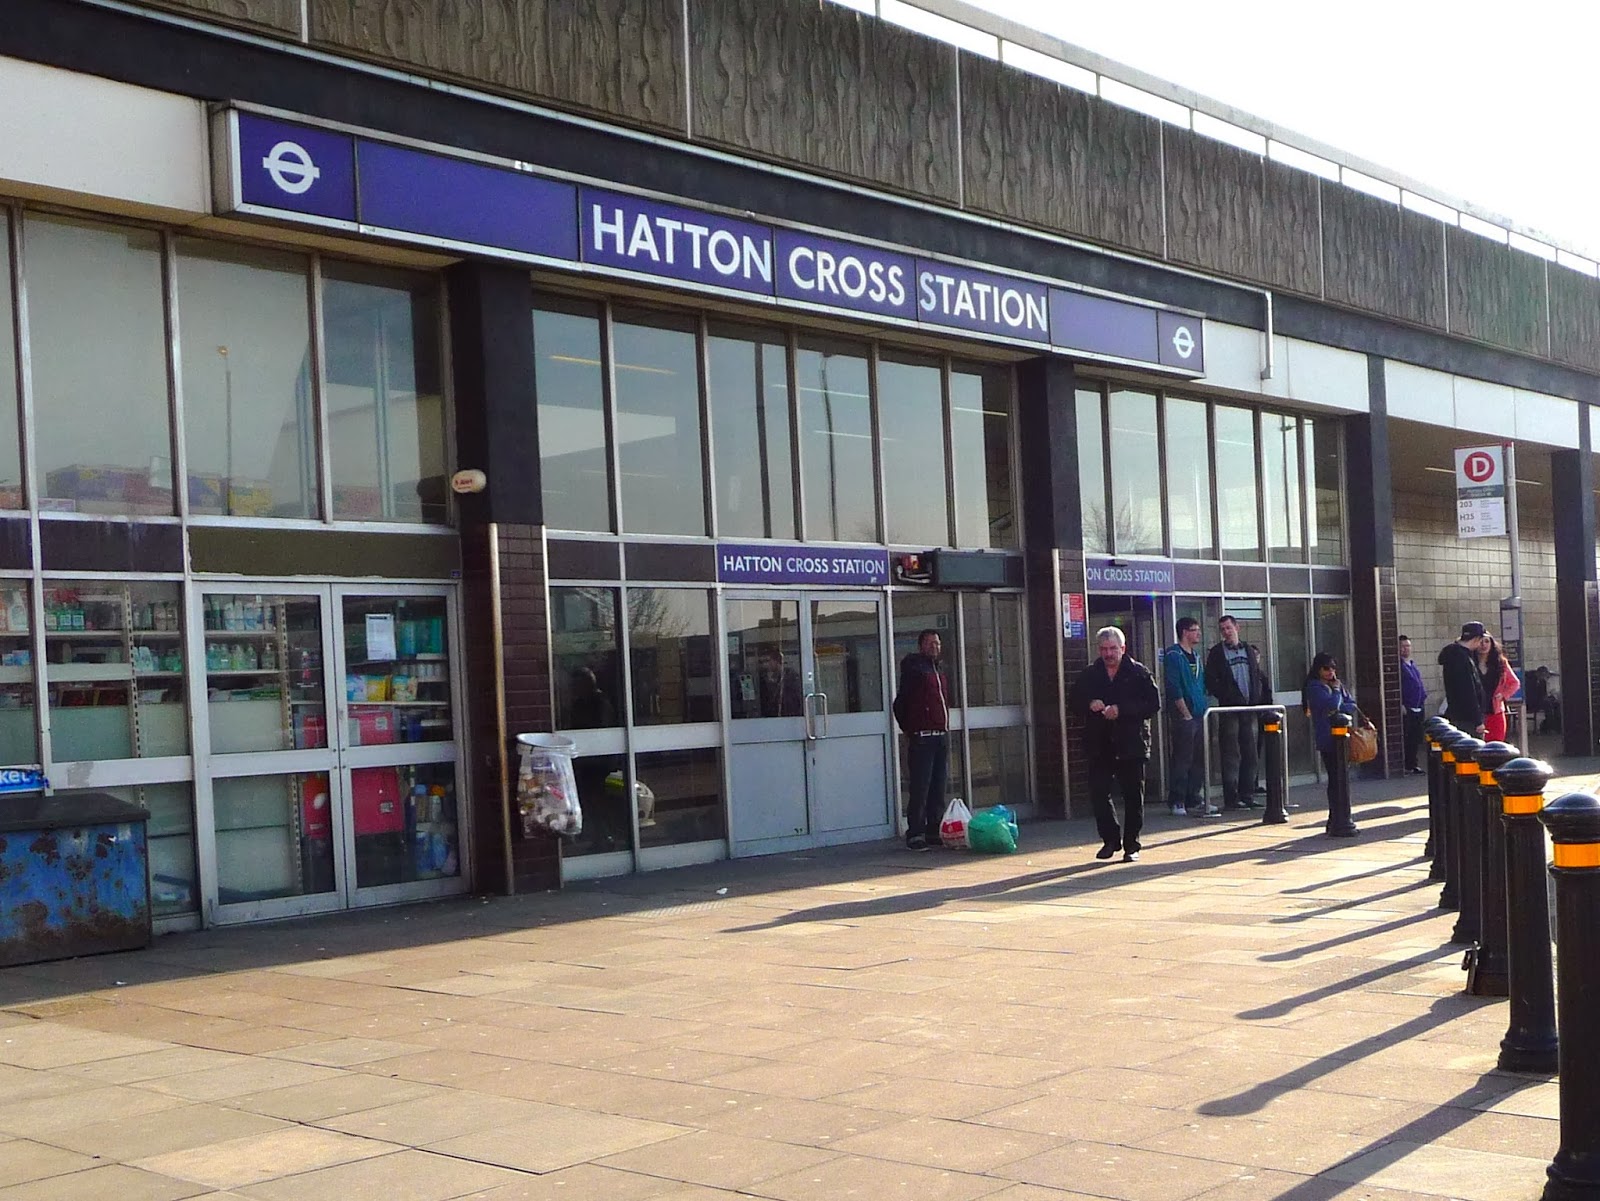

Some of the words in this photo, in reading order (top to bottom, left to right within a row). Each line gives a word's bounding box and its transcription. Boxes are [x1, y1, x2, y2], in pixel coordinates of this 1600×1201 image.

[592, 203, 772, 283] HATTON
[788, 246, 905, 306] CROSS
[919, 271, 1048, 332] STATION
[1471, 457, 1490, 477] D
[1459, 500, 1473, 508] 203
[723, 555, 782, 573] HATTON
[786, 557, 829, 574] CROSS
[832, 558, 885, 575] STATION
[1103, 568, 1133, 582] CROSS
[1134, 569, 1171, 583] STATION
